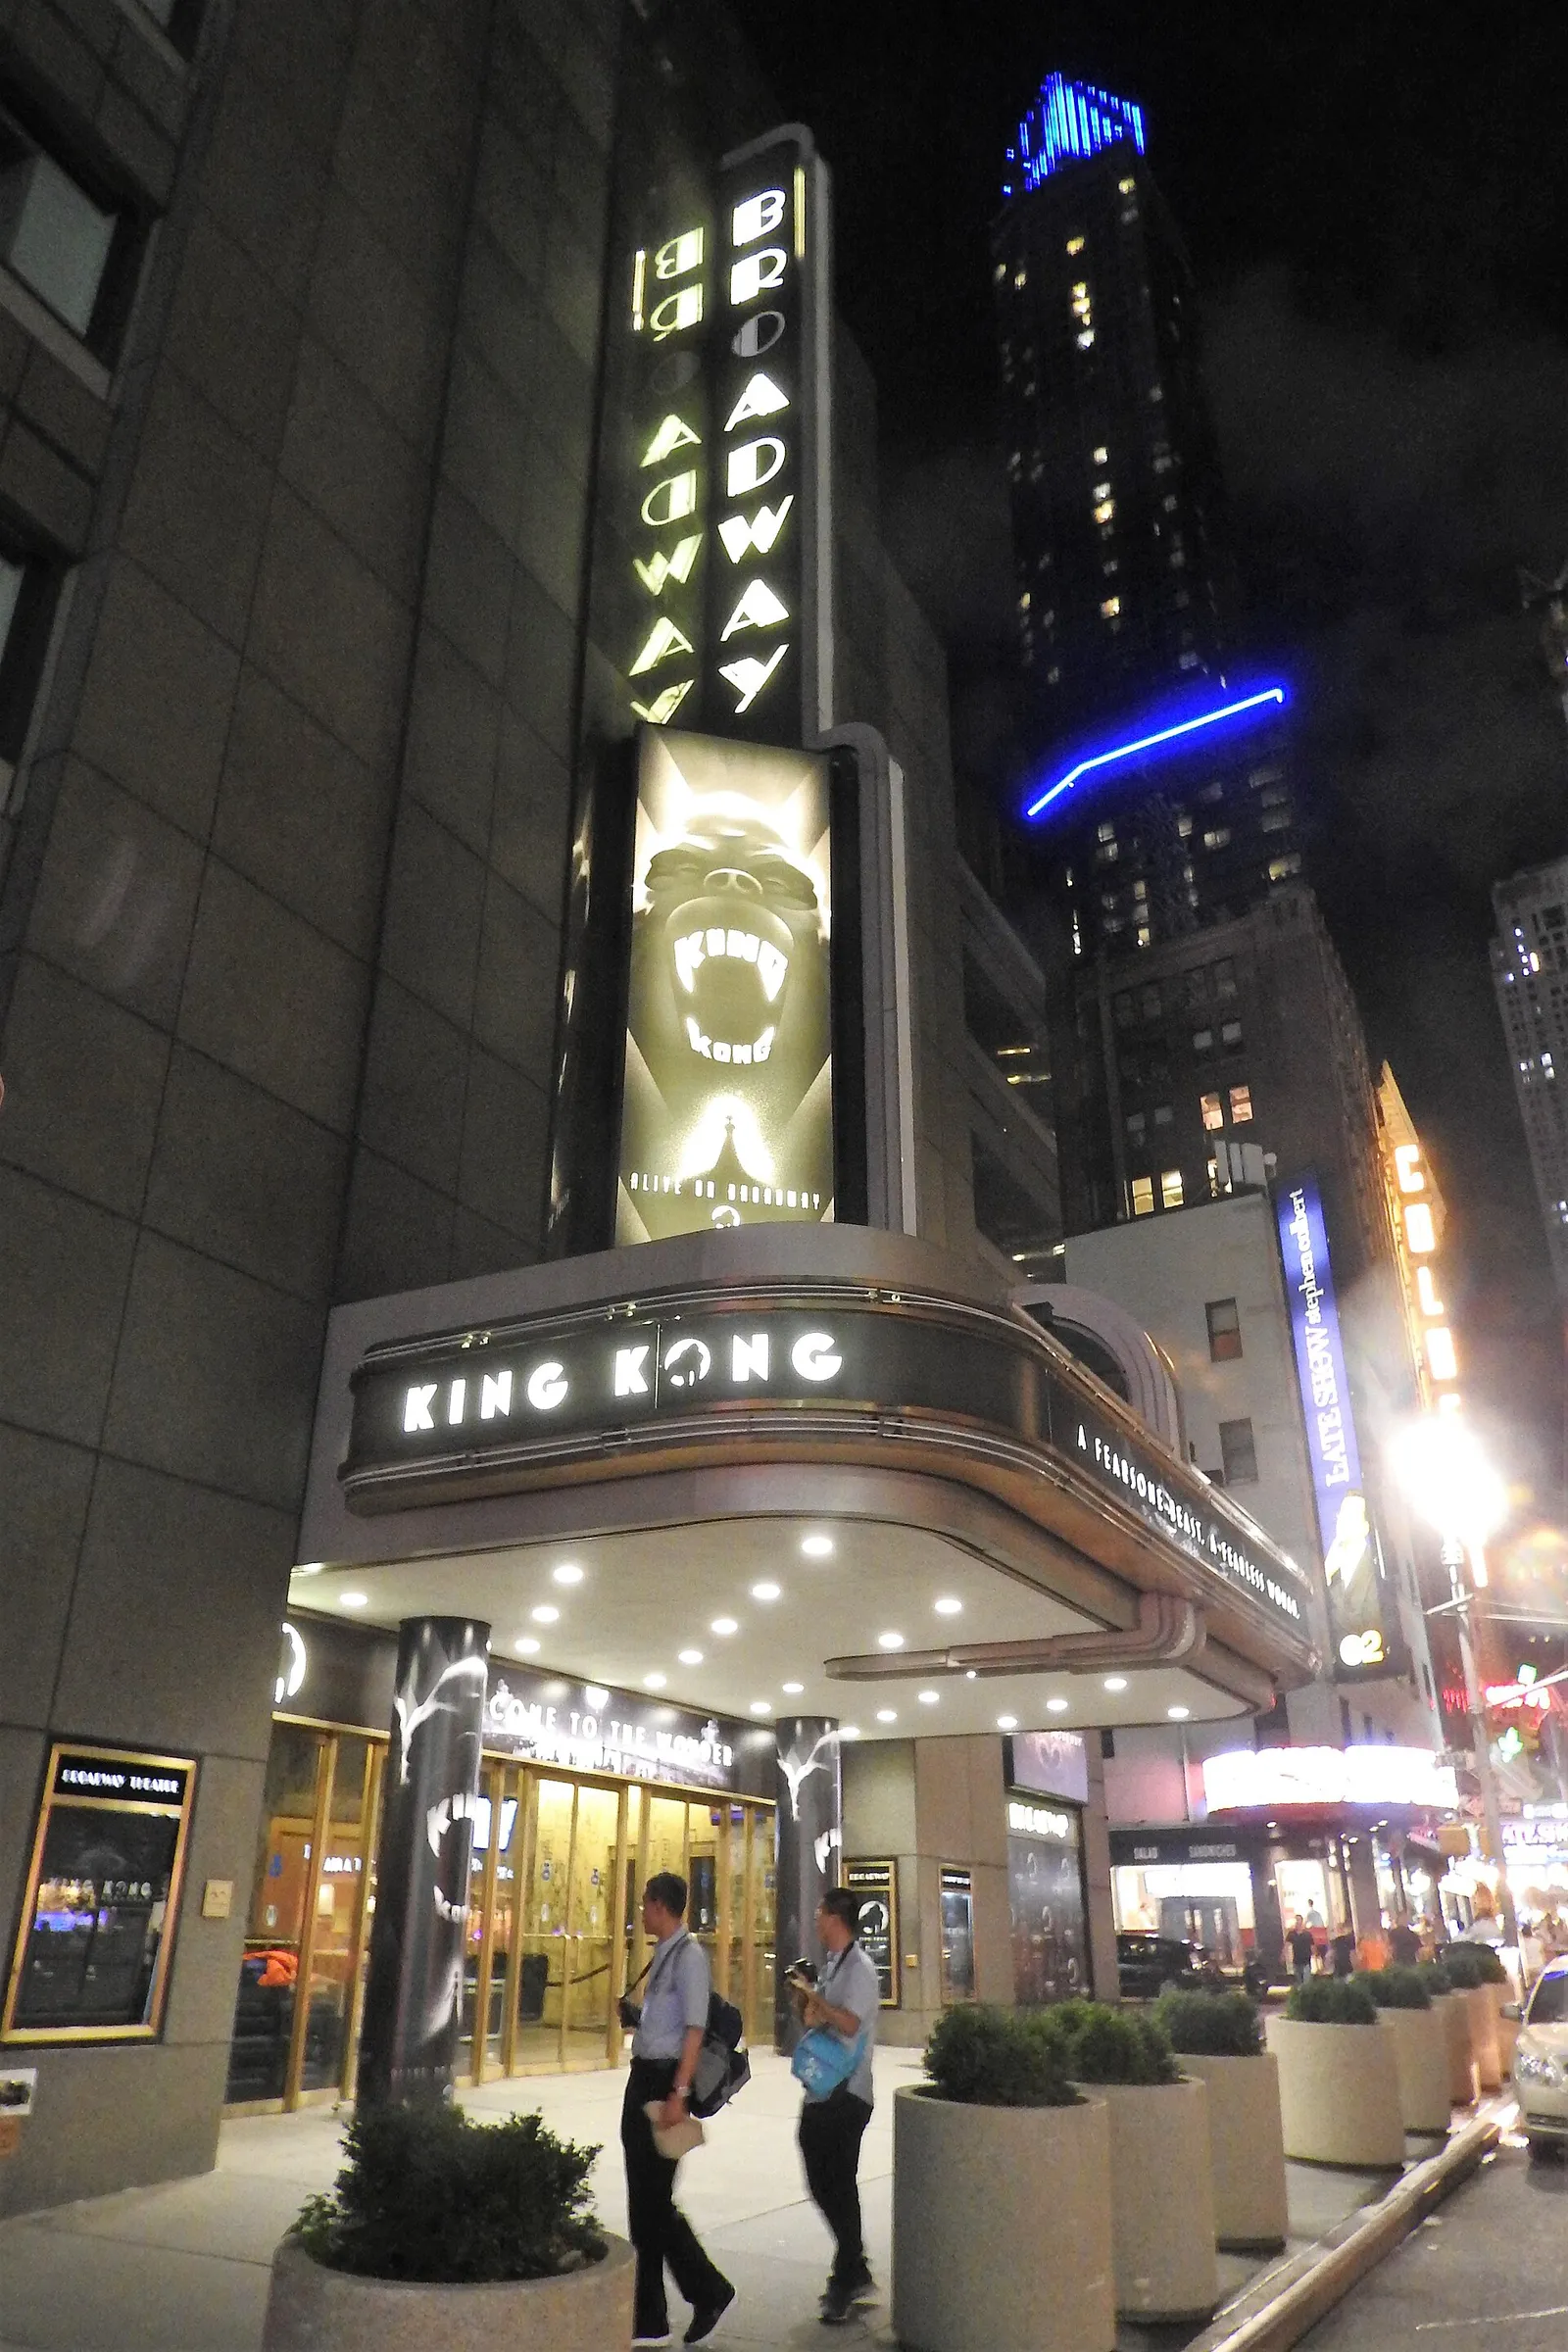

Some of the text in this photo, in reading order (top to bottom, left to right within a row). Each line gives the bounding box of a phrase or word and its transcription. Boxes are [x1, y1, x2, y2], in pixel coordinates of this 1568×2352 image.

[718, 187, 795, 713] BROADWAY
[673, 927, 789, 1003] KING
[686, 1016, 776, 1065] KONG
[1298, 1250, 1325, 1325] stephen
[402, 1332, 843, 1433] KING KONG
[1304, 1325, 1339, 1408] SHOW
[1077, 1424, 1087, 1450] A
[1094, 1437, 1164, 1512] FEARSOME
[1316, 1405, 1350, 1488] LATE
[489, 1693, 558, 1735] COME
[569, 1711, 599, 1740] TO
[610, 1720, 648, 1748] THE
[61, 1768, 125, 1788] BROADWAY
